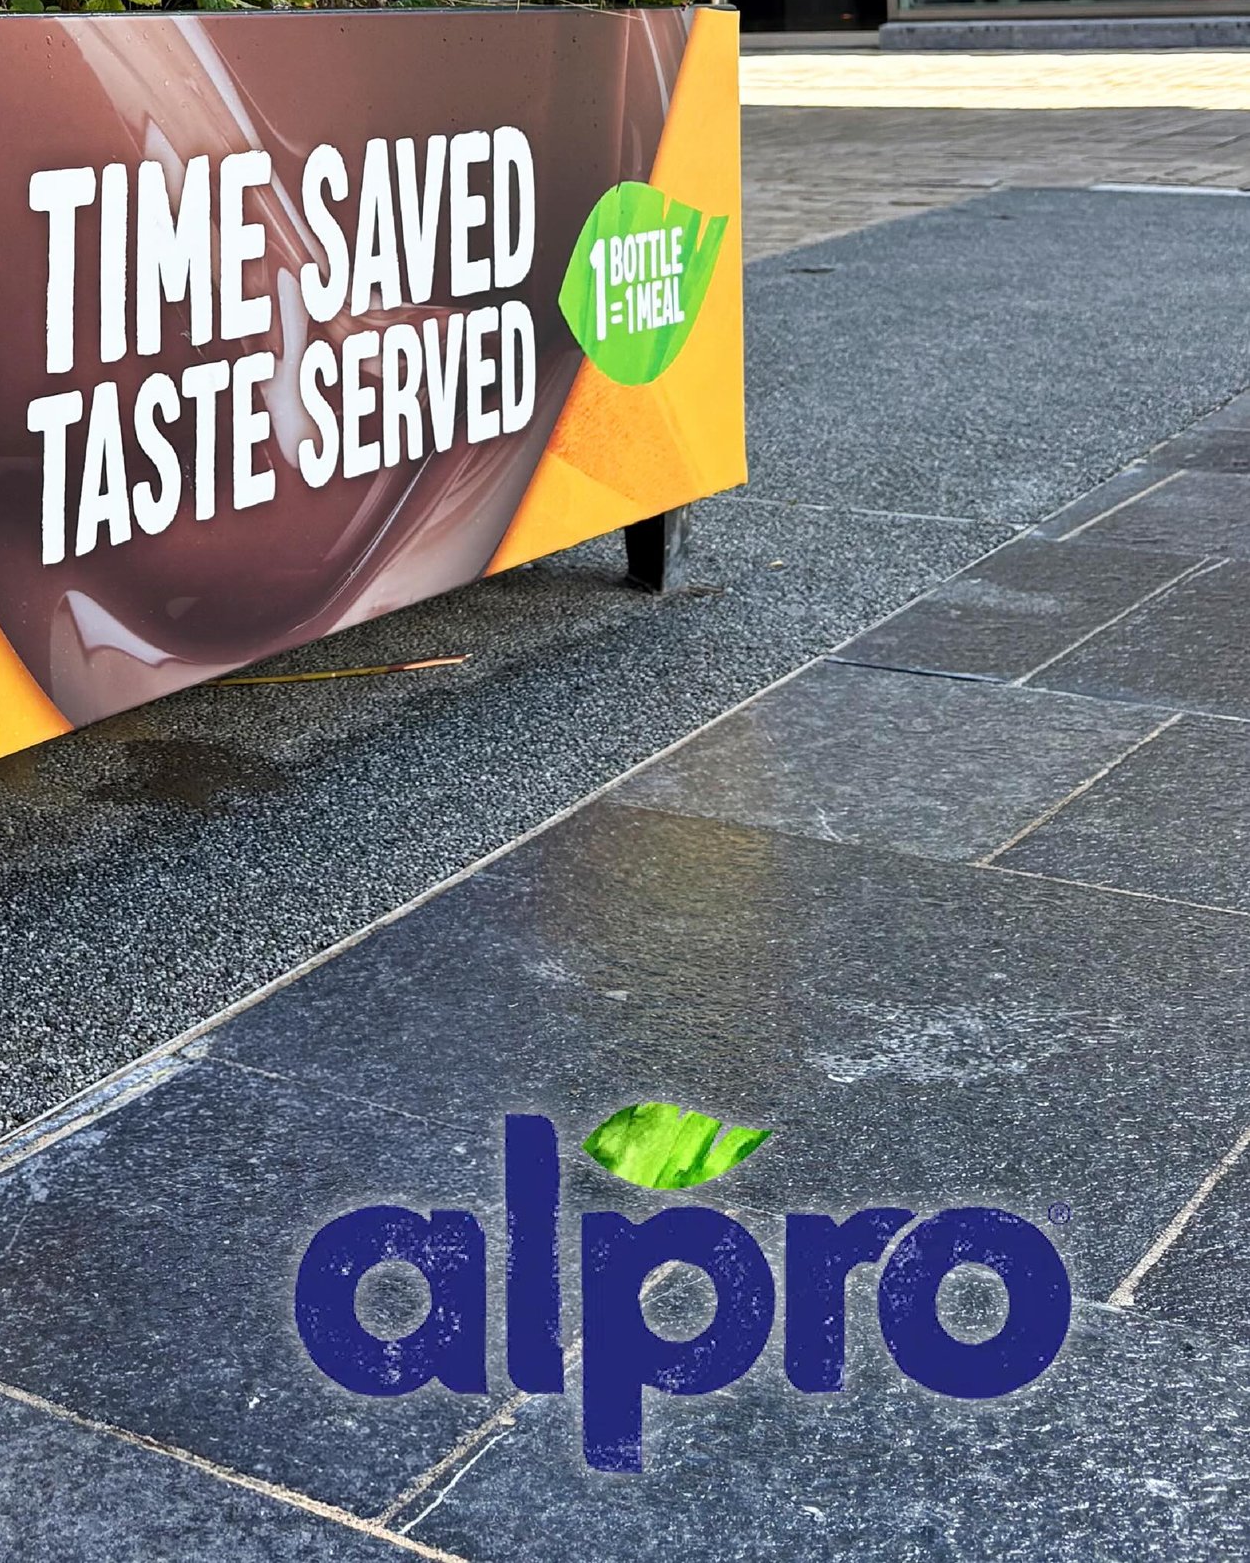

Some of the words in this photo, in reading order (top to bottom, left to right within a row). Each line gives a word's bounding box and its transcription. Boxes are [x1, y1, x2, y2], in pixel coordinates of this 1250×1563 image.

[27, 149, 272, 374] TIME
[299, 125, 536, 323] SAVED
[589, 238, 607, 341] 1
[609, 226, 683, 286] BOTTLE
[26, 351, 277, 565] TASTE
[298, 300, 536, 489] SERVED
